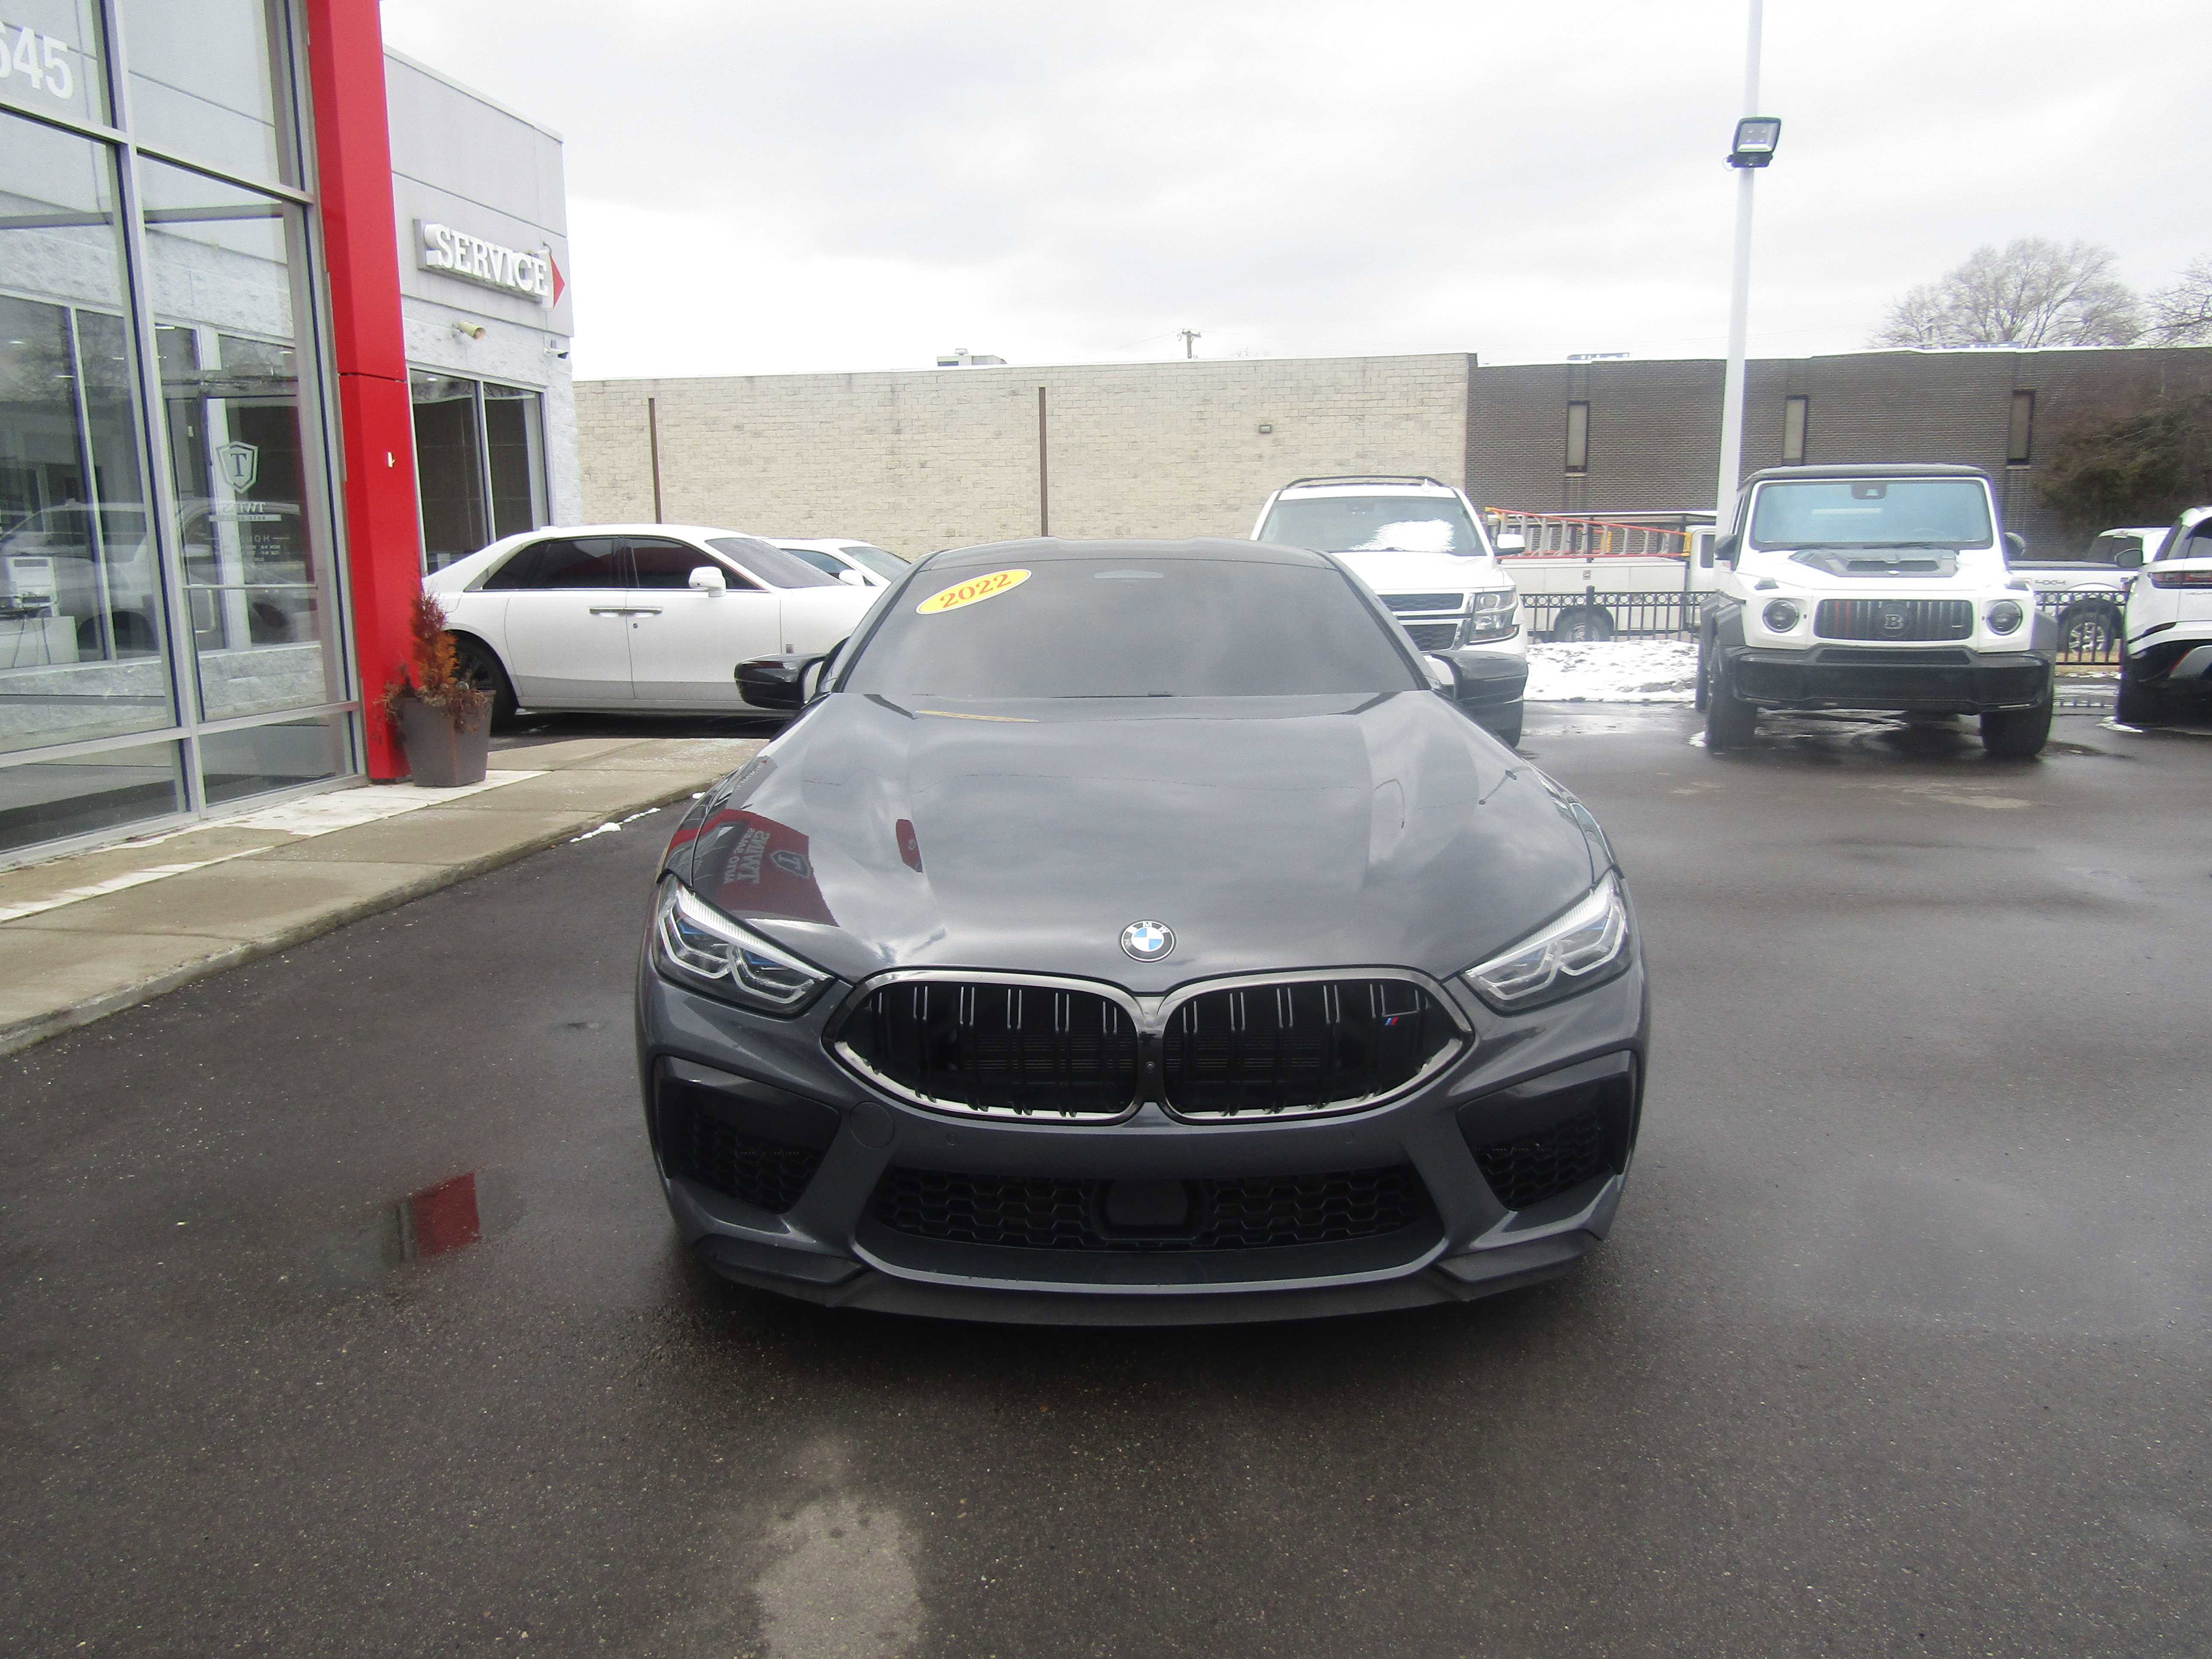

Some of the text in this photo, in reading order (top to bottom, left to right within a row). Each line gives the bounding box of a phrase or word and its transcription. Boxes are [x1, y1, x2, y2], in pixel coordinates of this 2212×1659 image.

[424, 224, 549, 296] SERVICE
[940, 574, 1011, 608] 2022
[1884, 614, 1903, 629] B
